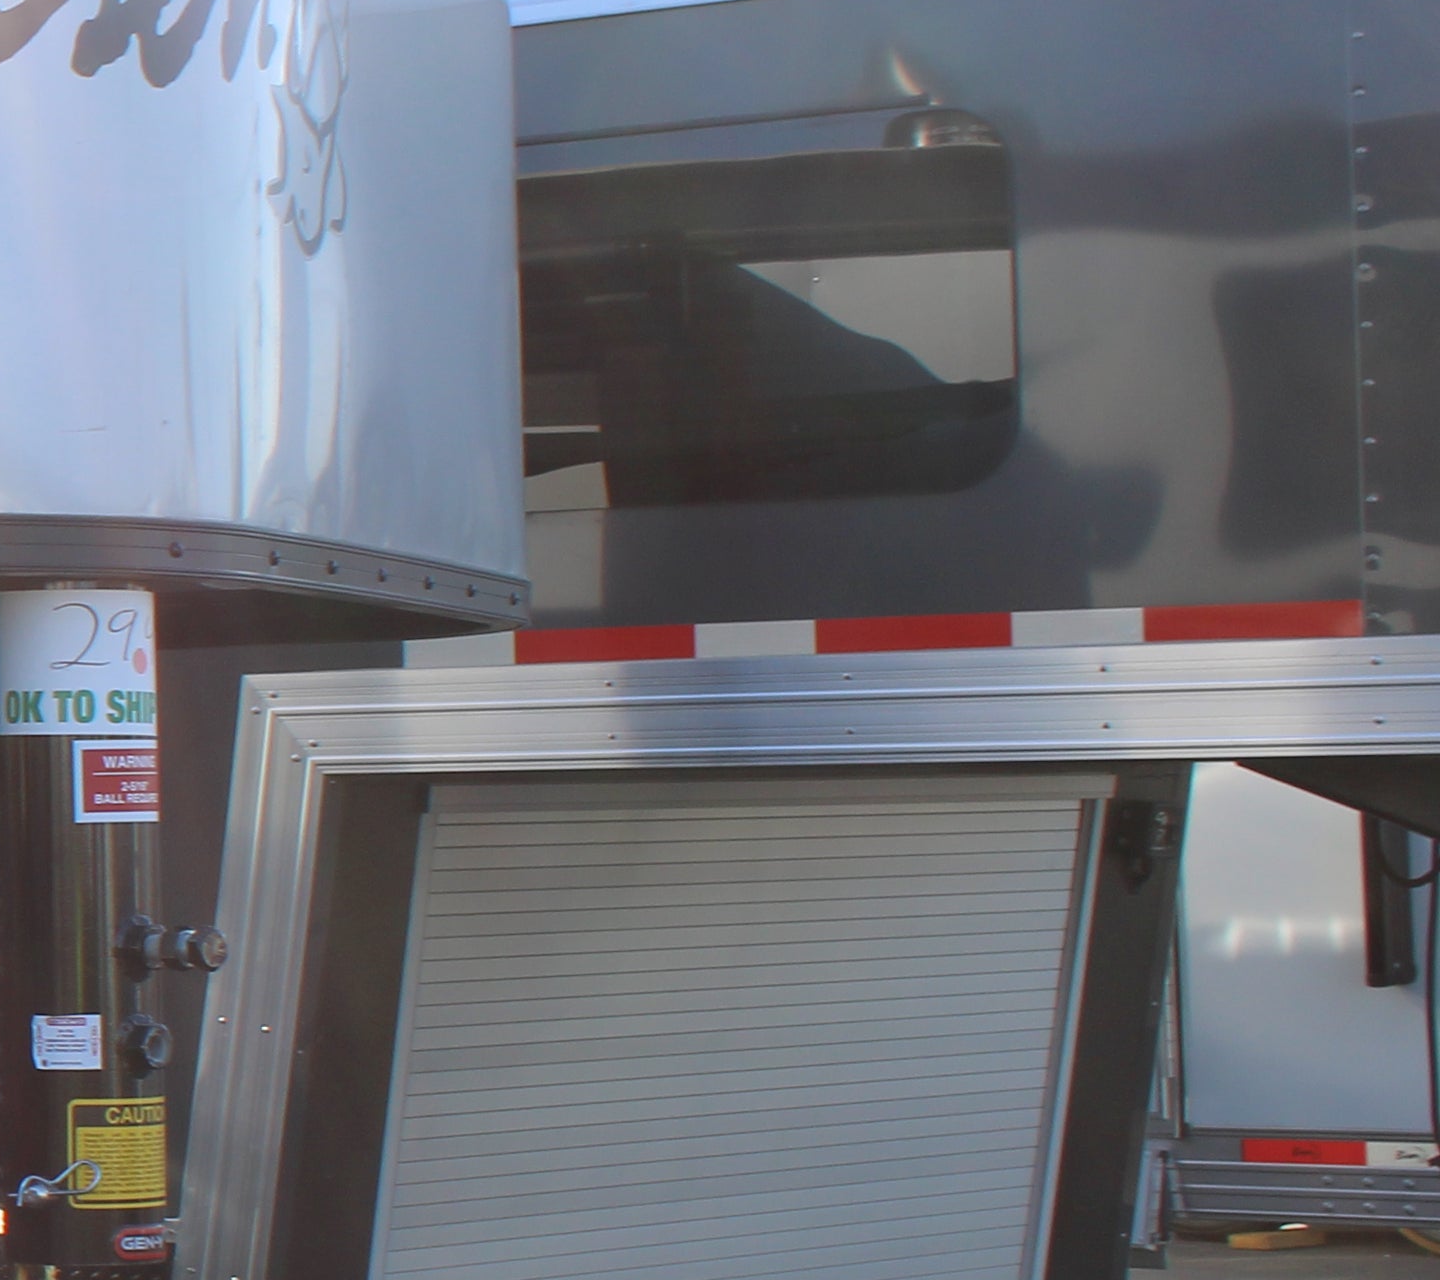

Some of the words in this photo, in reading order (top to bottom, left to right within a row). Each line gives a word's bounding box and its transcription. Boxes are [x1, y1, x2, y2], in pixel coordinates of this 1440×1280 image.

[5, 689, 45, 724] OK
[51, 689, 96, 724] TO
[93, 793, 126, 805] BALL
[105, 1105, 166, 1125] CAUTIO
